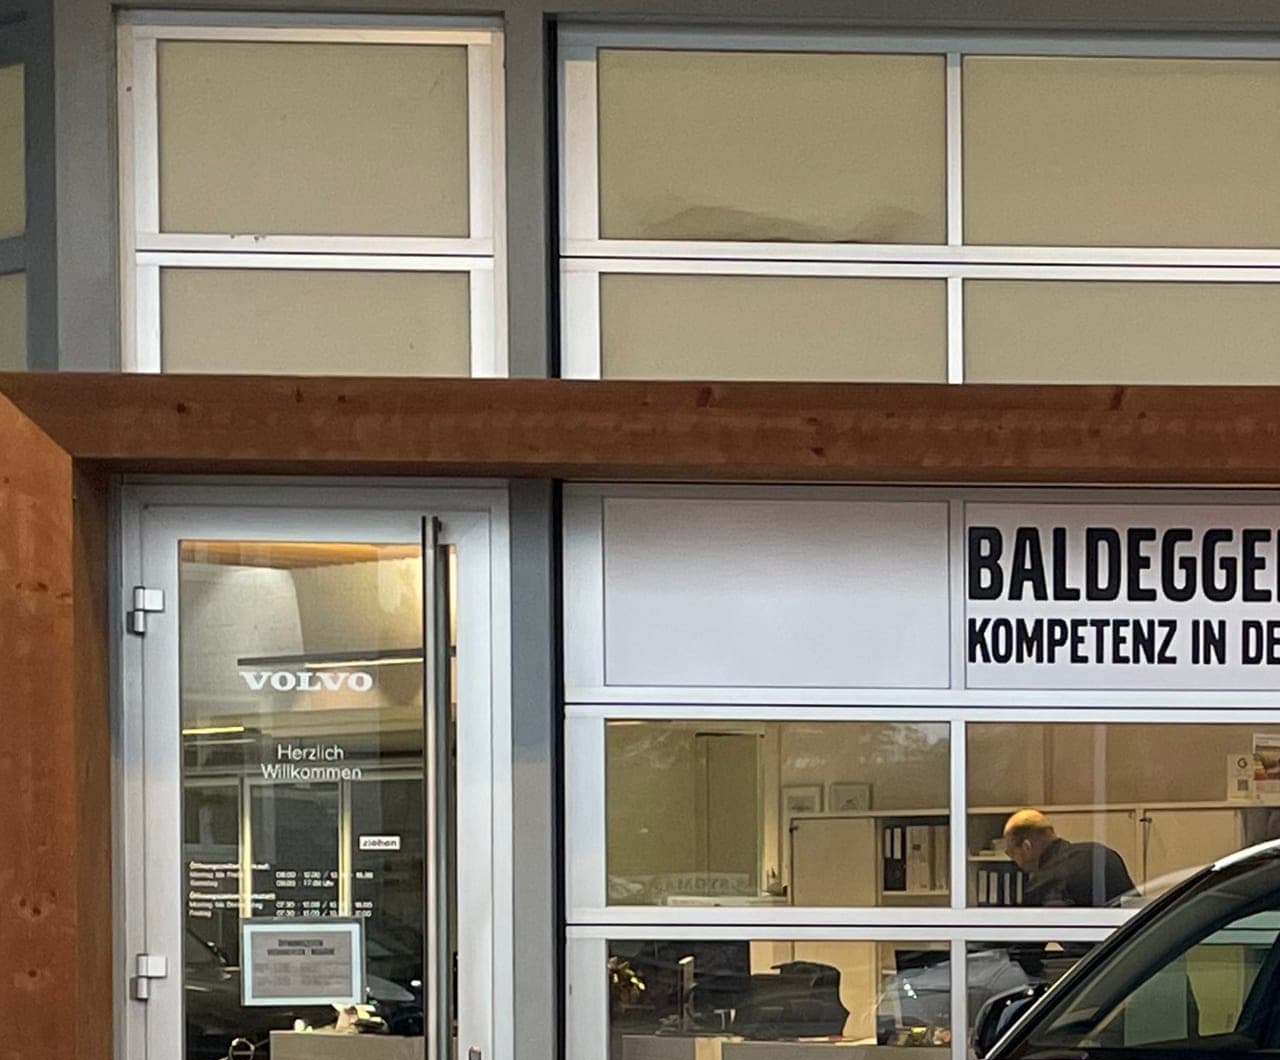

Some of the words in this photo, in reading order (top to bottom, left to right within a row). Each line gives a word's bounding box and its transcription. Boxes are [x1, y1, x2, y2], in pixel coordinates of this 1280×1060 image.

[968, 618, 1178, 664] KOMPETENZ
[1191, 619, 1227, 665] IN
[240, 671, 373, 692] VOLVO
[277, 744, 344, 760] Herzlich
[261, 763, 361, 780] Willkommen
[362, 839, 397, 848] ziehen
